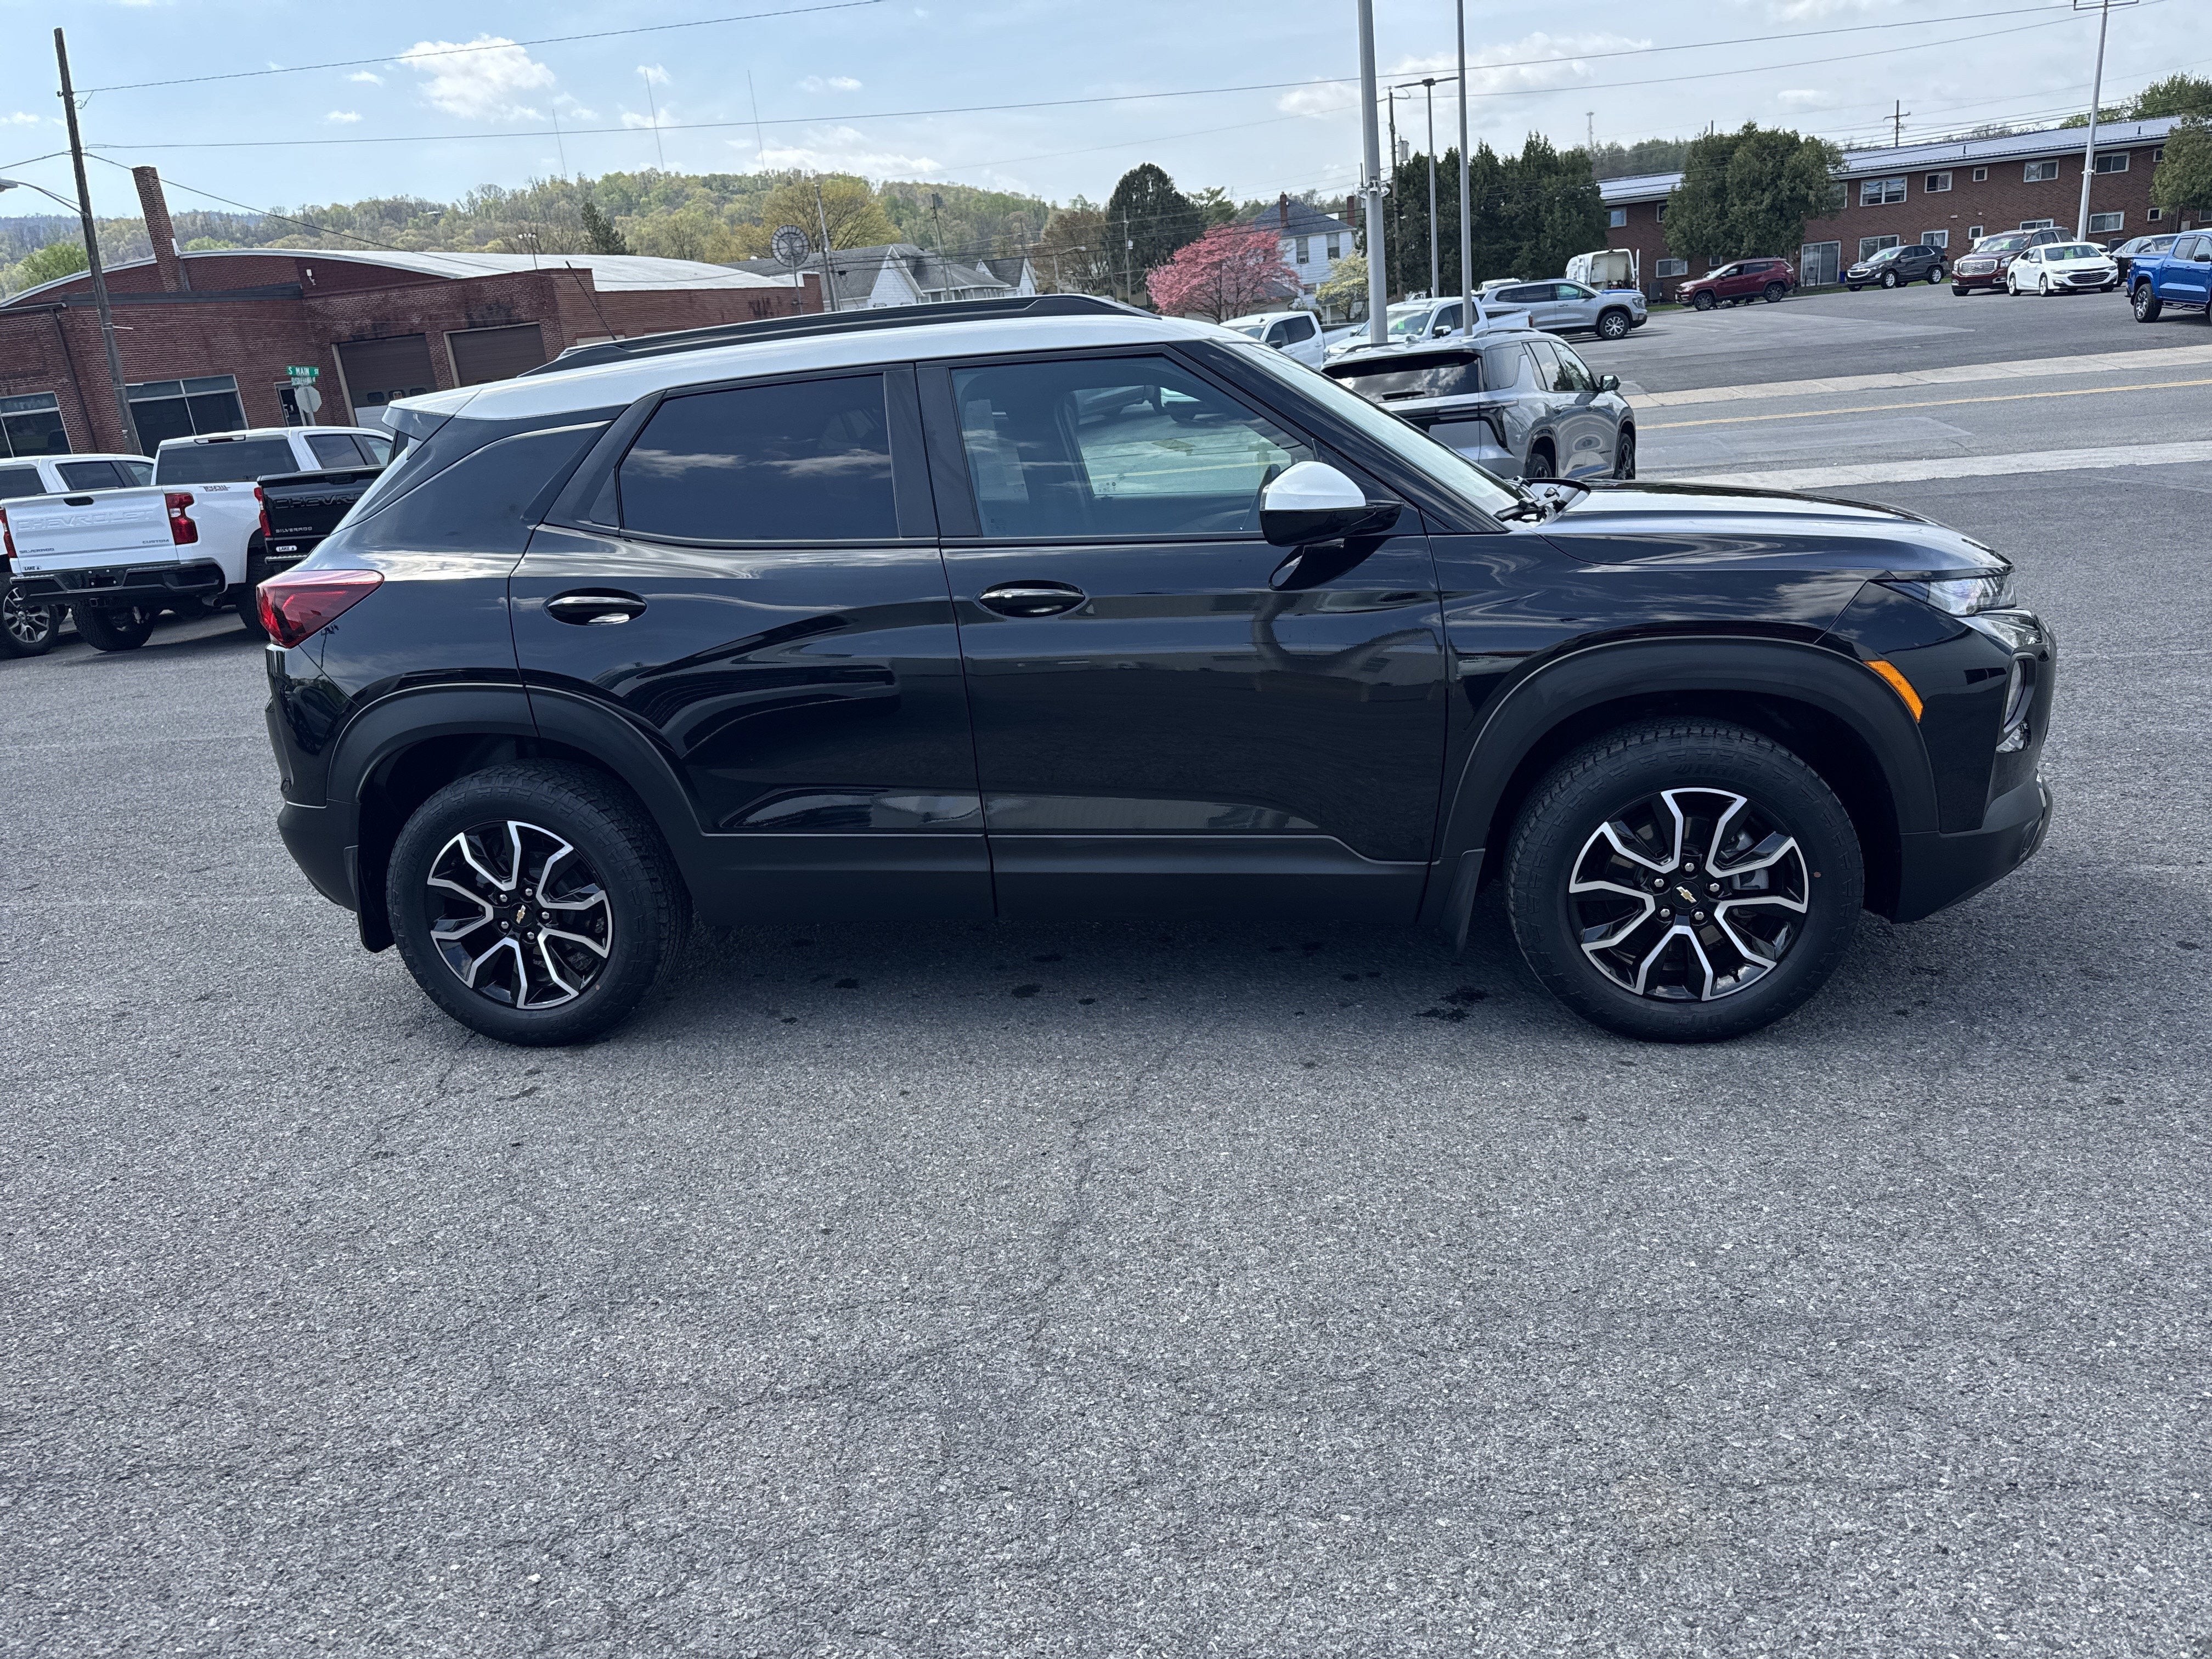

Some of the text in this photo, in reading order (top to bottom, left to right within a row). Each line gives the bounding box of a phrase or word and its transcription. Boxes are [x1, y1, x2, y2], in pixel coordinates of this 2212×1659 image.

[288, 366, 293, 375] S
[296, 367, 310, 376] MAIN
[274, 494, 364, 509] CHEVR
[18, 510, 154, 531] CHEVROLET
